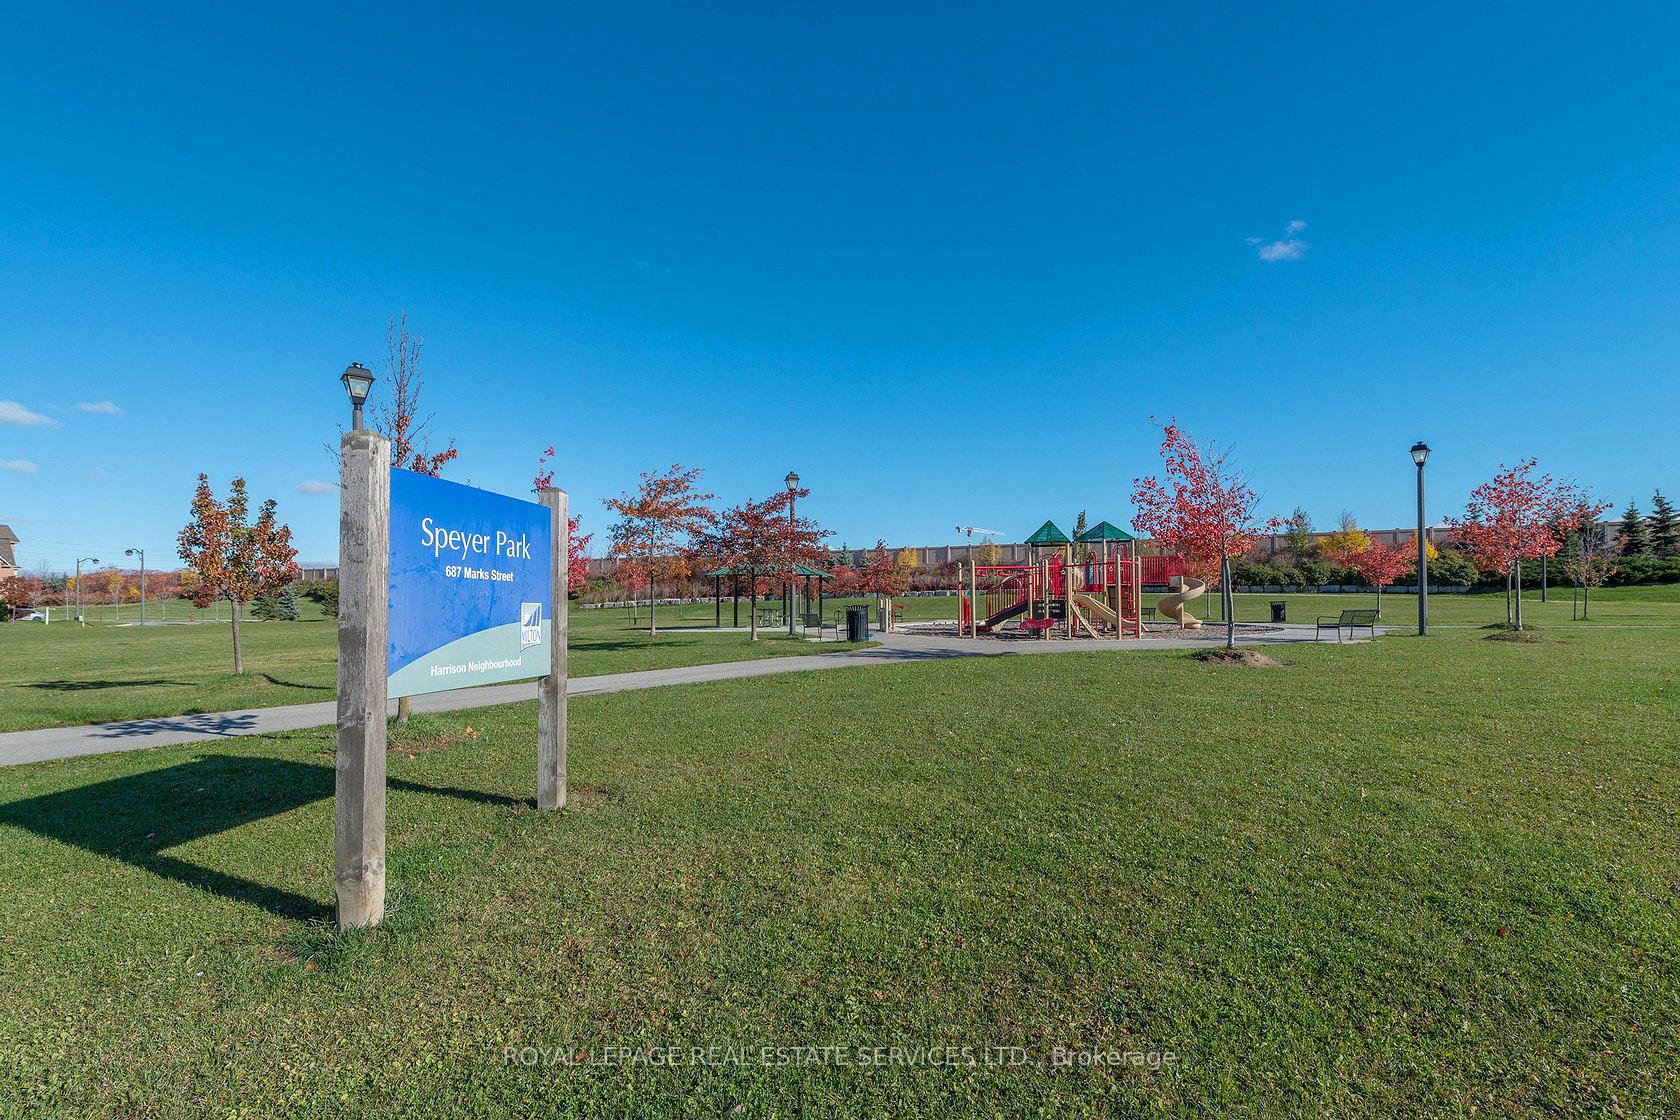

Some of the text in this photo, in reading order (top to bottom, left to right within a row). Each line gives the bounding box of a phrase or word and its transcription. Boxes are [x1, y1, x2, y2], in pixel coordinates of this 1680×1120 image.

[421, 517, 531, 560] Speyer Park
[445, 565, 514, 582] 687 Marks Street
[431, 657, 522, 676] Harrison Neighbourhood
